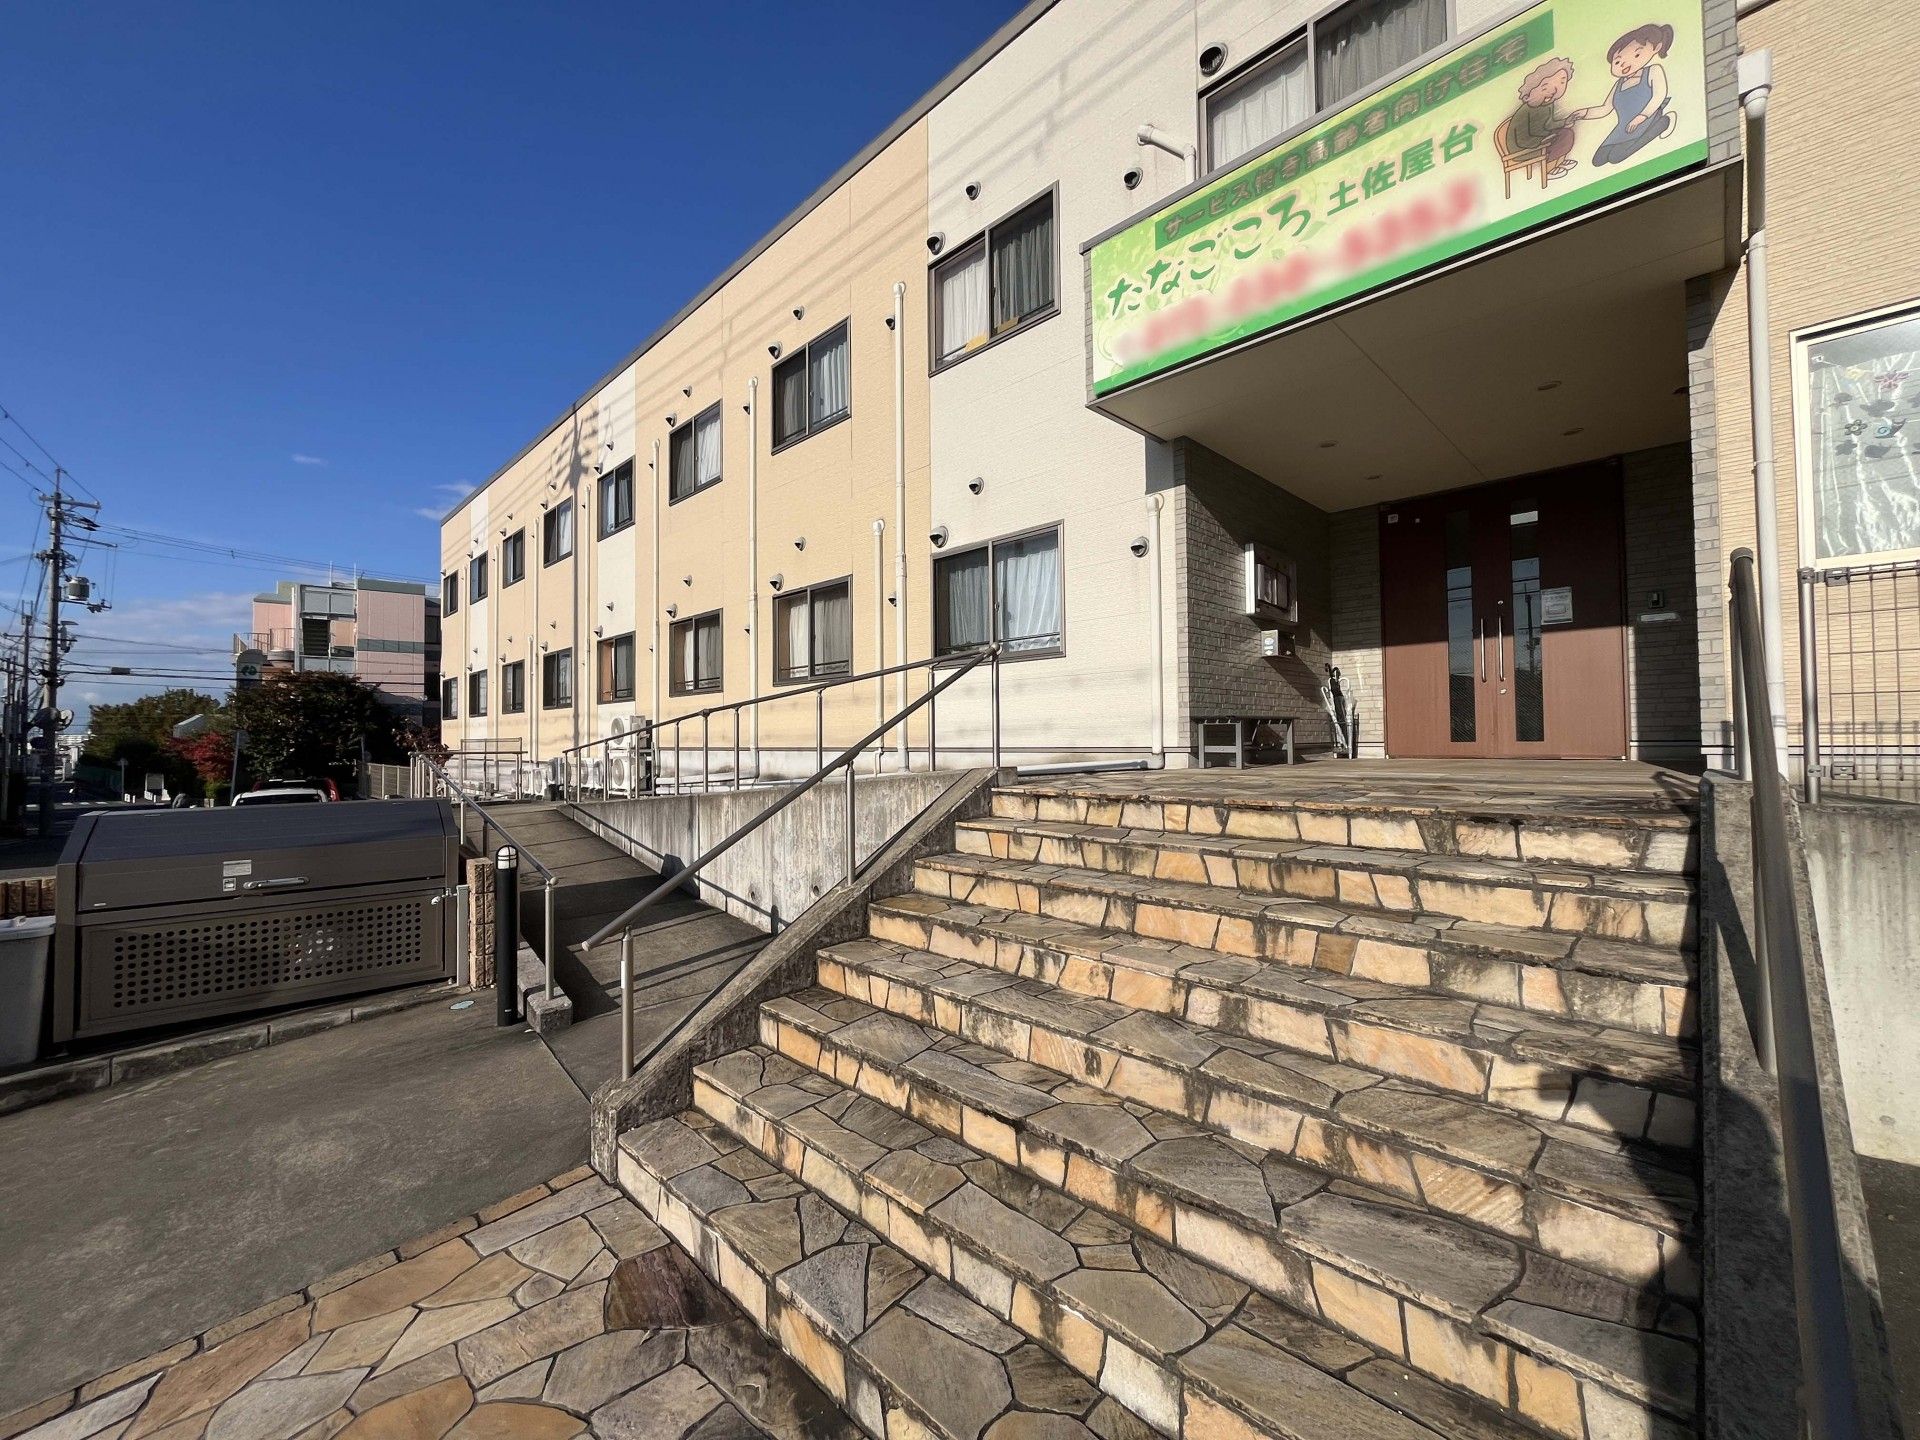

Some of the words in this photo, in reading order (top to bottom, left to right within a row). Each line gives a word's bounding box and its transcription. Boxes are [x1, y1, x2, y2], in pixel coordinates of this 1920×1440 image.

[1107, 194, 1312, 316] たなごころ
[1327, 123, 1478, 217] 土佐屋台
